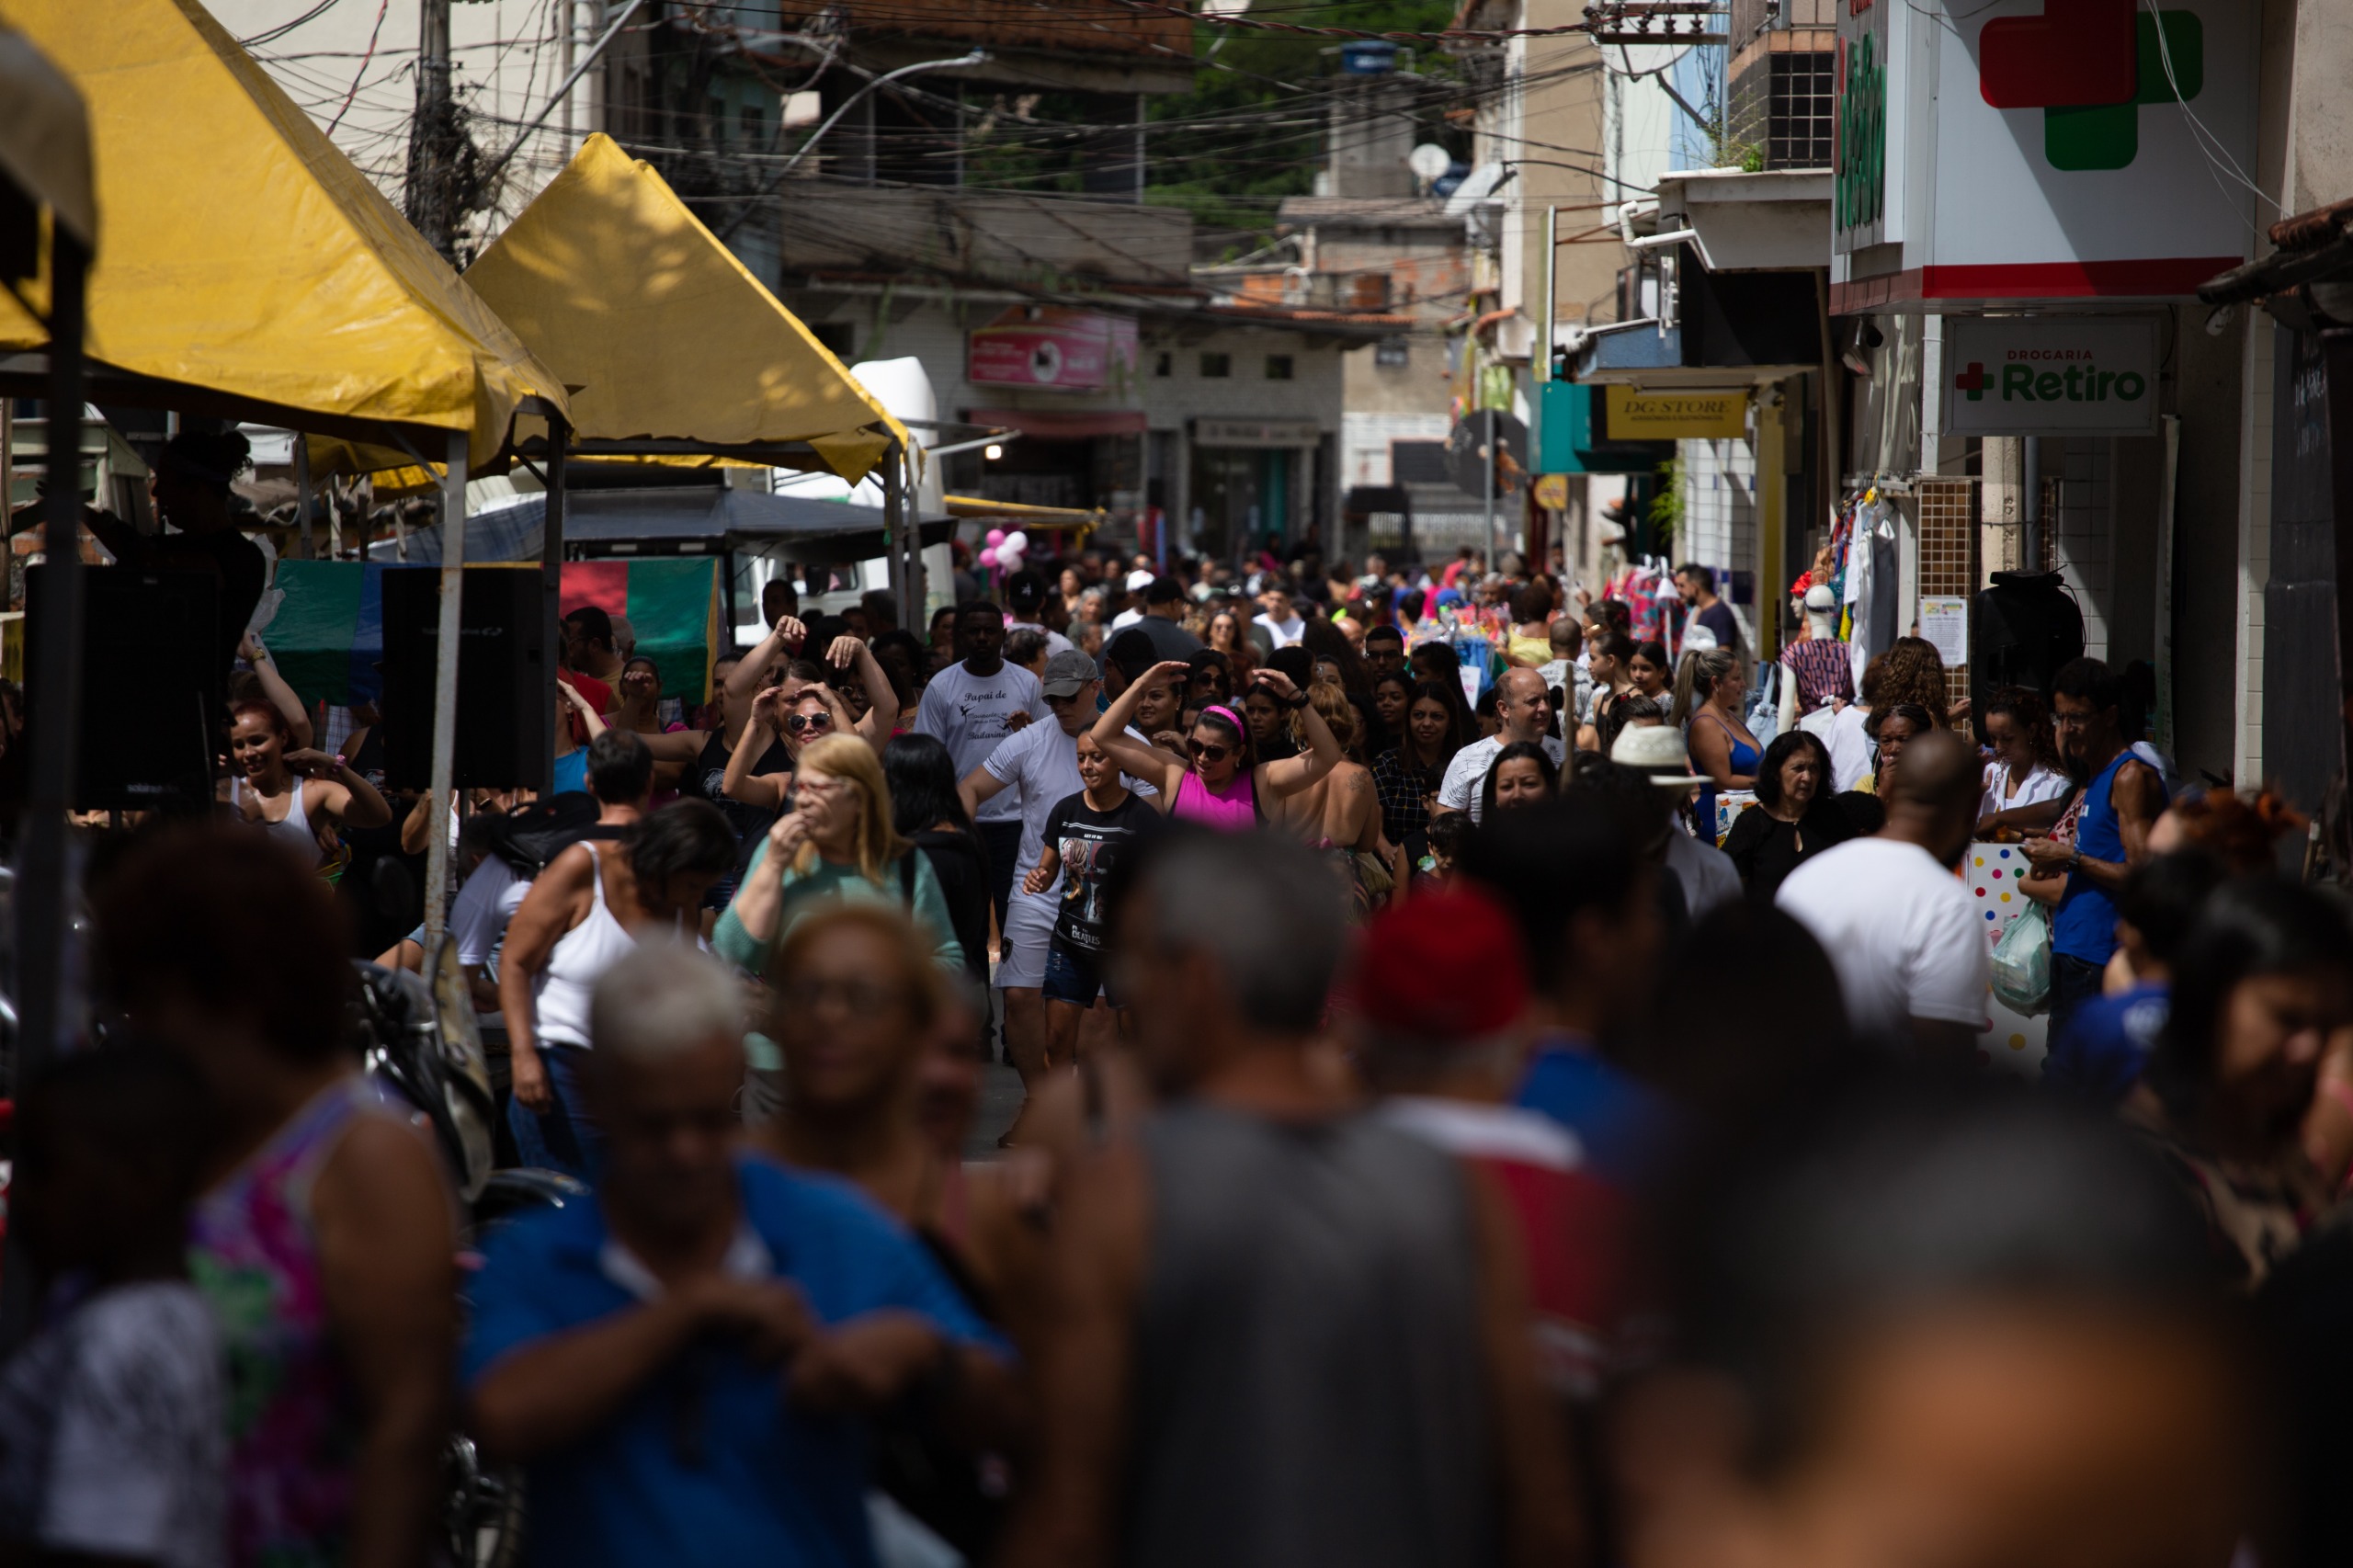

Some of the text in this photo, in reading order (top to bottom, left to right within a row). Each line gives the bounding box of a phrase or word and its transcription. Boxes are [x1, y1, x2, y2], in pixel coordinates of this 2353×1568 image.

[2007, 349, 2093, 360] DROGARIA
[2002, 363, 2145, 402] Retiro
[1624, 400, 1732, 413] DG STORE
[964, 690, 1006, 702] Papai de
[968, 731, 1006, 740] Bailarina
[1072, 924, 1101, 945] BEATLES
